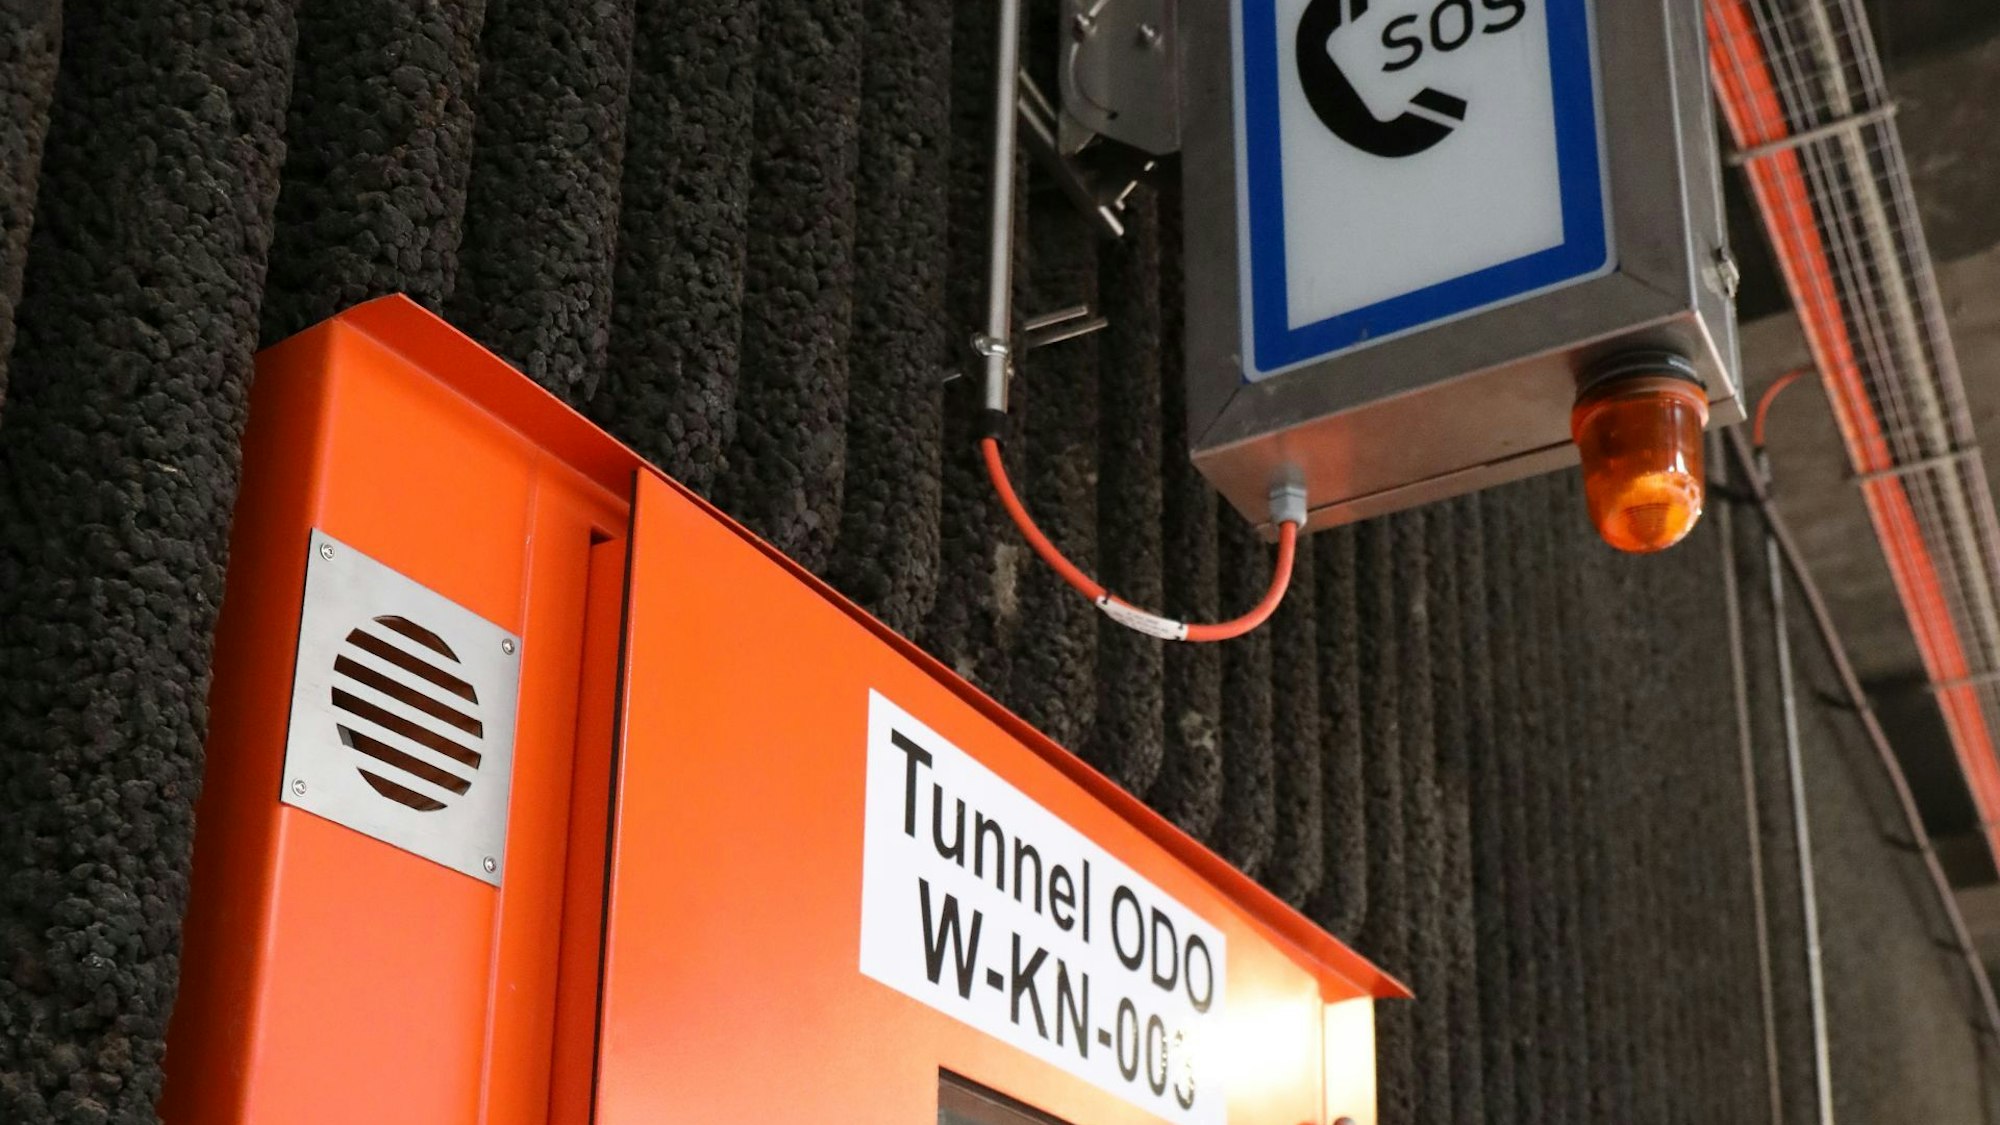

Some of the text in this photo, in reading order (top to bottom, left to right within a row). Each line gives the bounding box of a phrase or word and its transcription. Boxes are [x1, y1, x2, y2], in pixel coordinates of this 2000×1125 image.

[1381, 0, 1526, 72] SOS
[891, 728, 1213, 1013] Tunnel ODO
